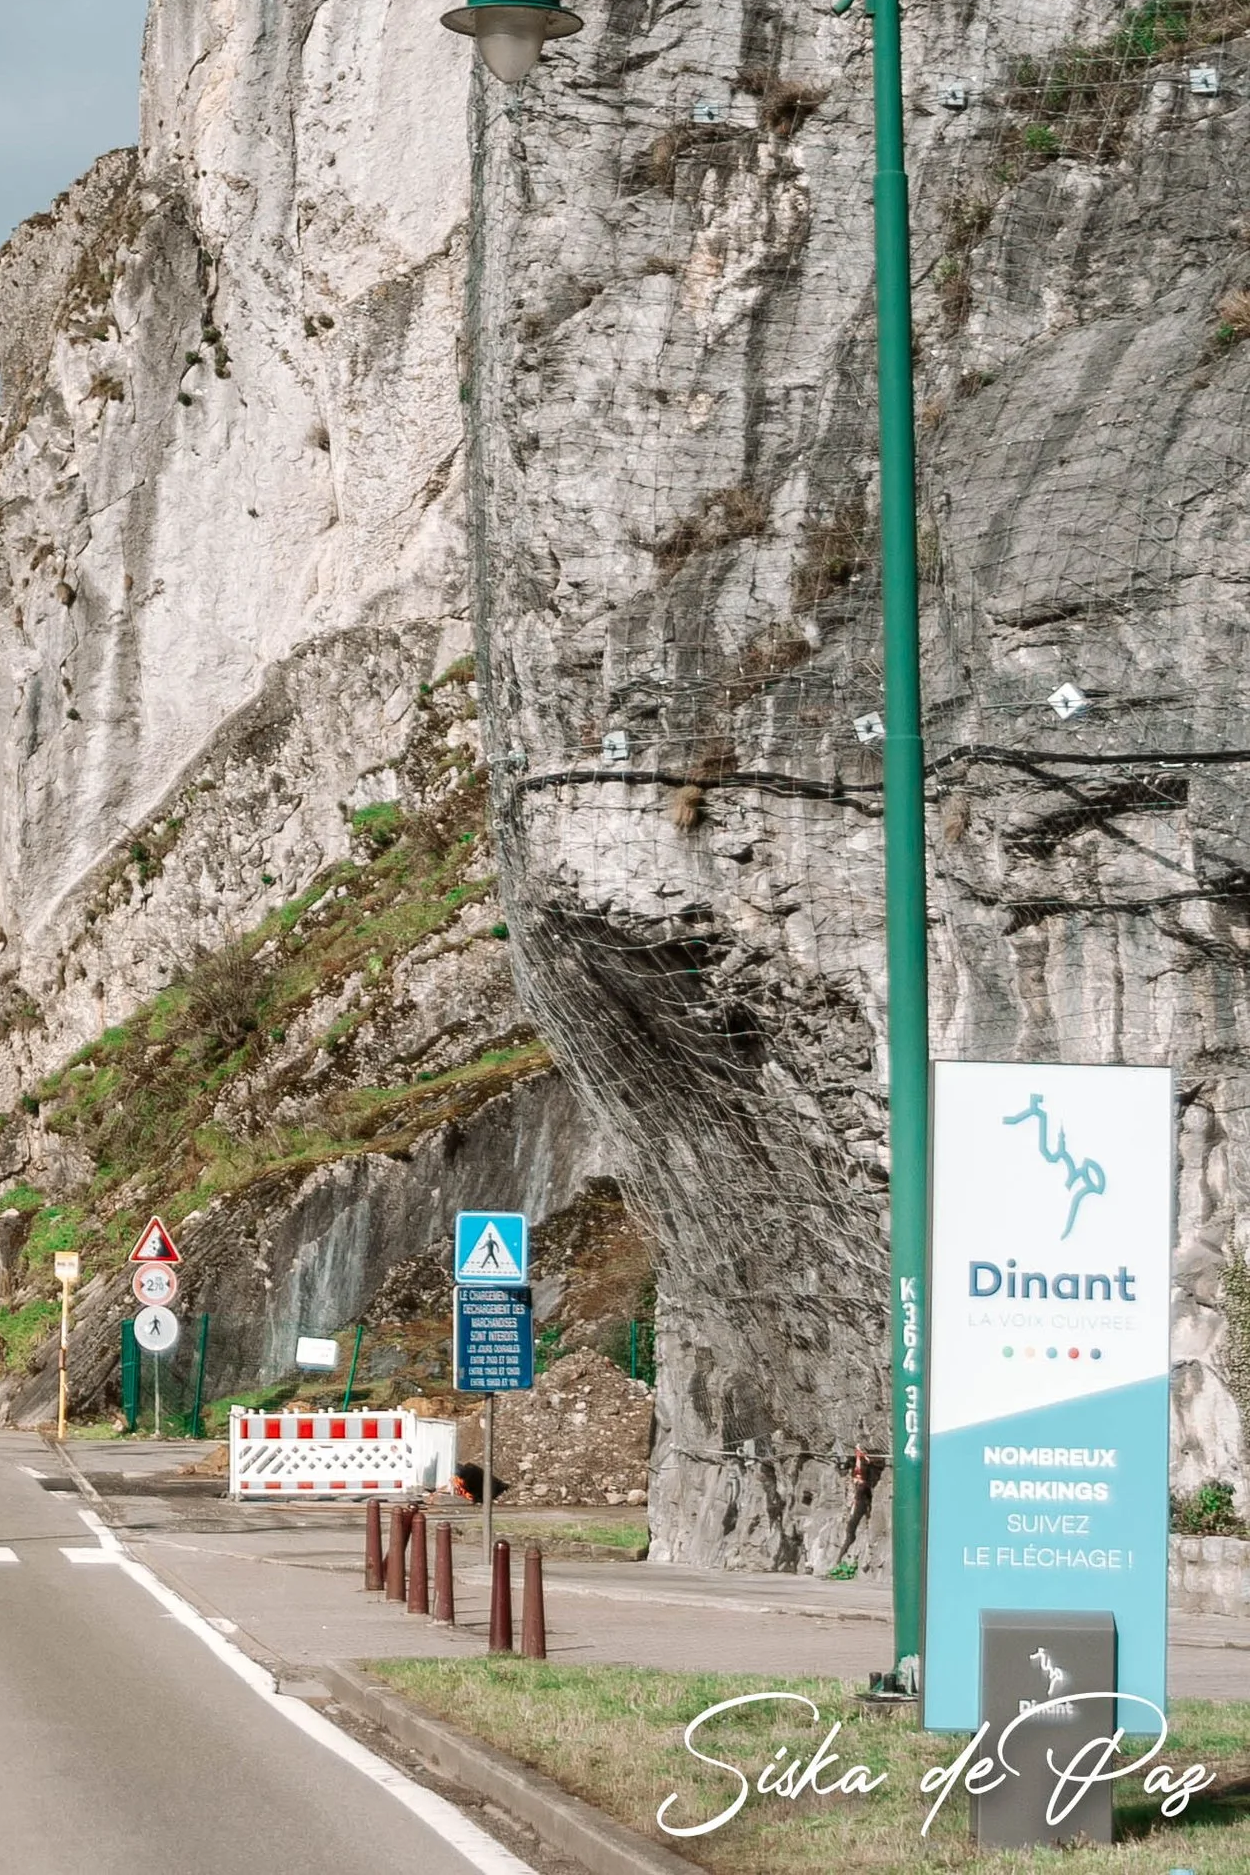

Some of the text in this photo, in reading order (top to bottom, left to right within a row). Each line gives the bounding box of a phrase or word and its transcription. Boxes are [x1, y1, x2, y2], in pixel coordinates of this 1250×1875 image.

[968, 1258, 1136, 1301] Dinant
[968, 1313, 990, 1328] LA
[998, 1313, 1045, 1329] VOIX
[983, 1446, 1117, 1467] NOMBREUX
[989, 1479, 1109, 1501] PARKINGS
[1006, 1513, 1090, 1534] SUIVEZ
[963, 1546, 990, 1566] LE
[996, 1542, 1122, 1568] FLÉCHAGE
